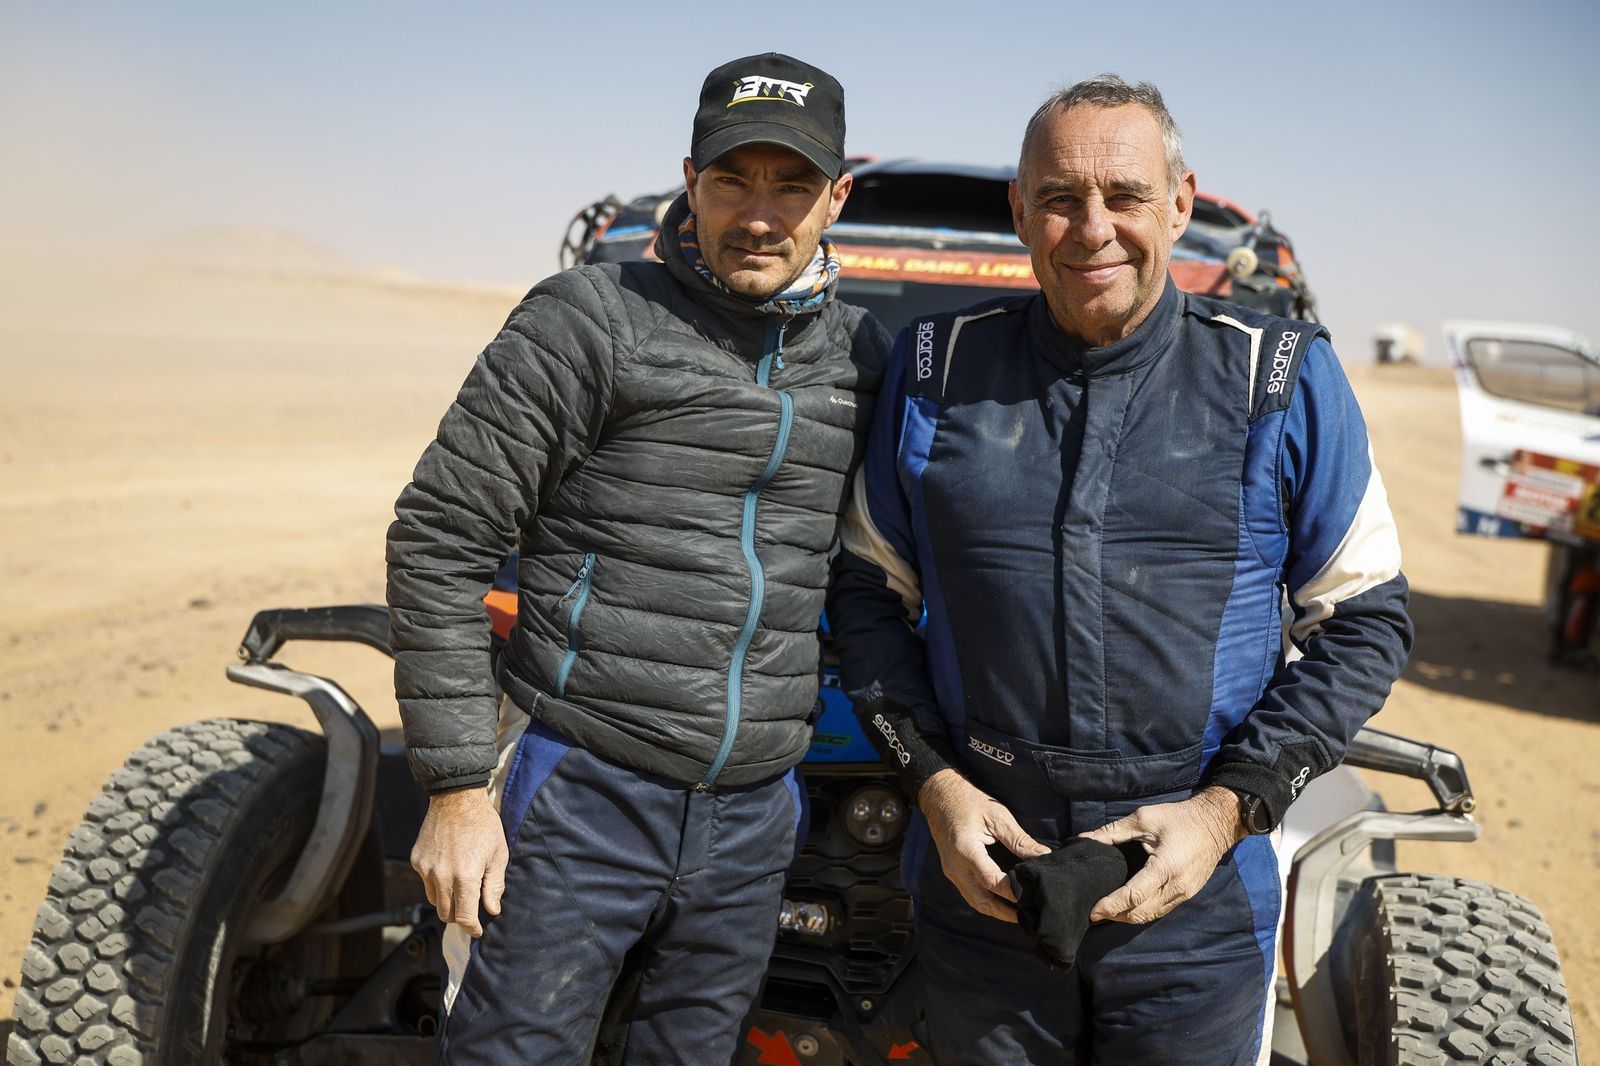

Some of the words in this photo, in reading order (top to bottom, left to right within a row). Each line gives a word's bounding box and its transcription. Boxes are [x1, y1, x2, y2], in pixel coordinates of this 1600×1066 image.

[731, 75, 812, 107] BTR
[916, 322, 935, 381] sparco
[1266, 331, 1301, 395] sparco
[872, 713, 911, 768] sparco
[967, 736, 1015, 767] sparco
